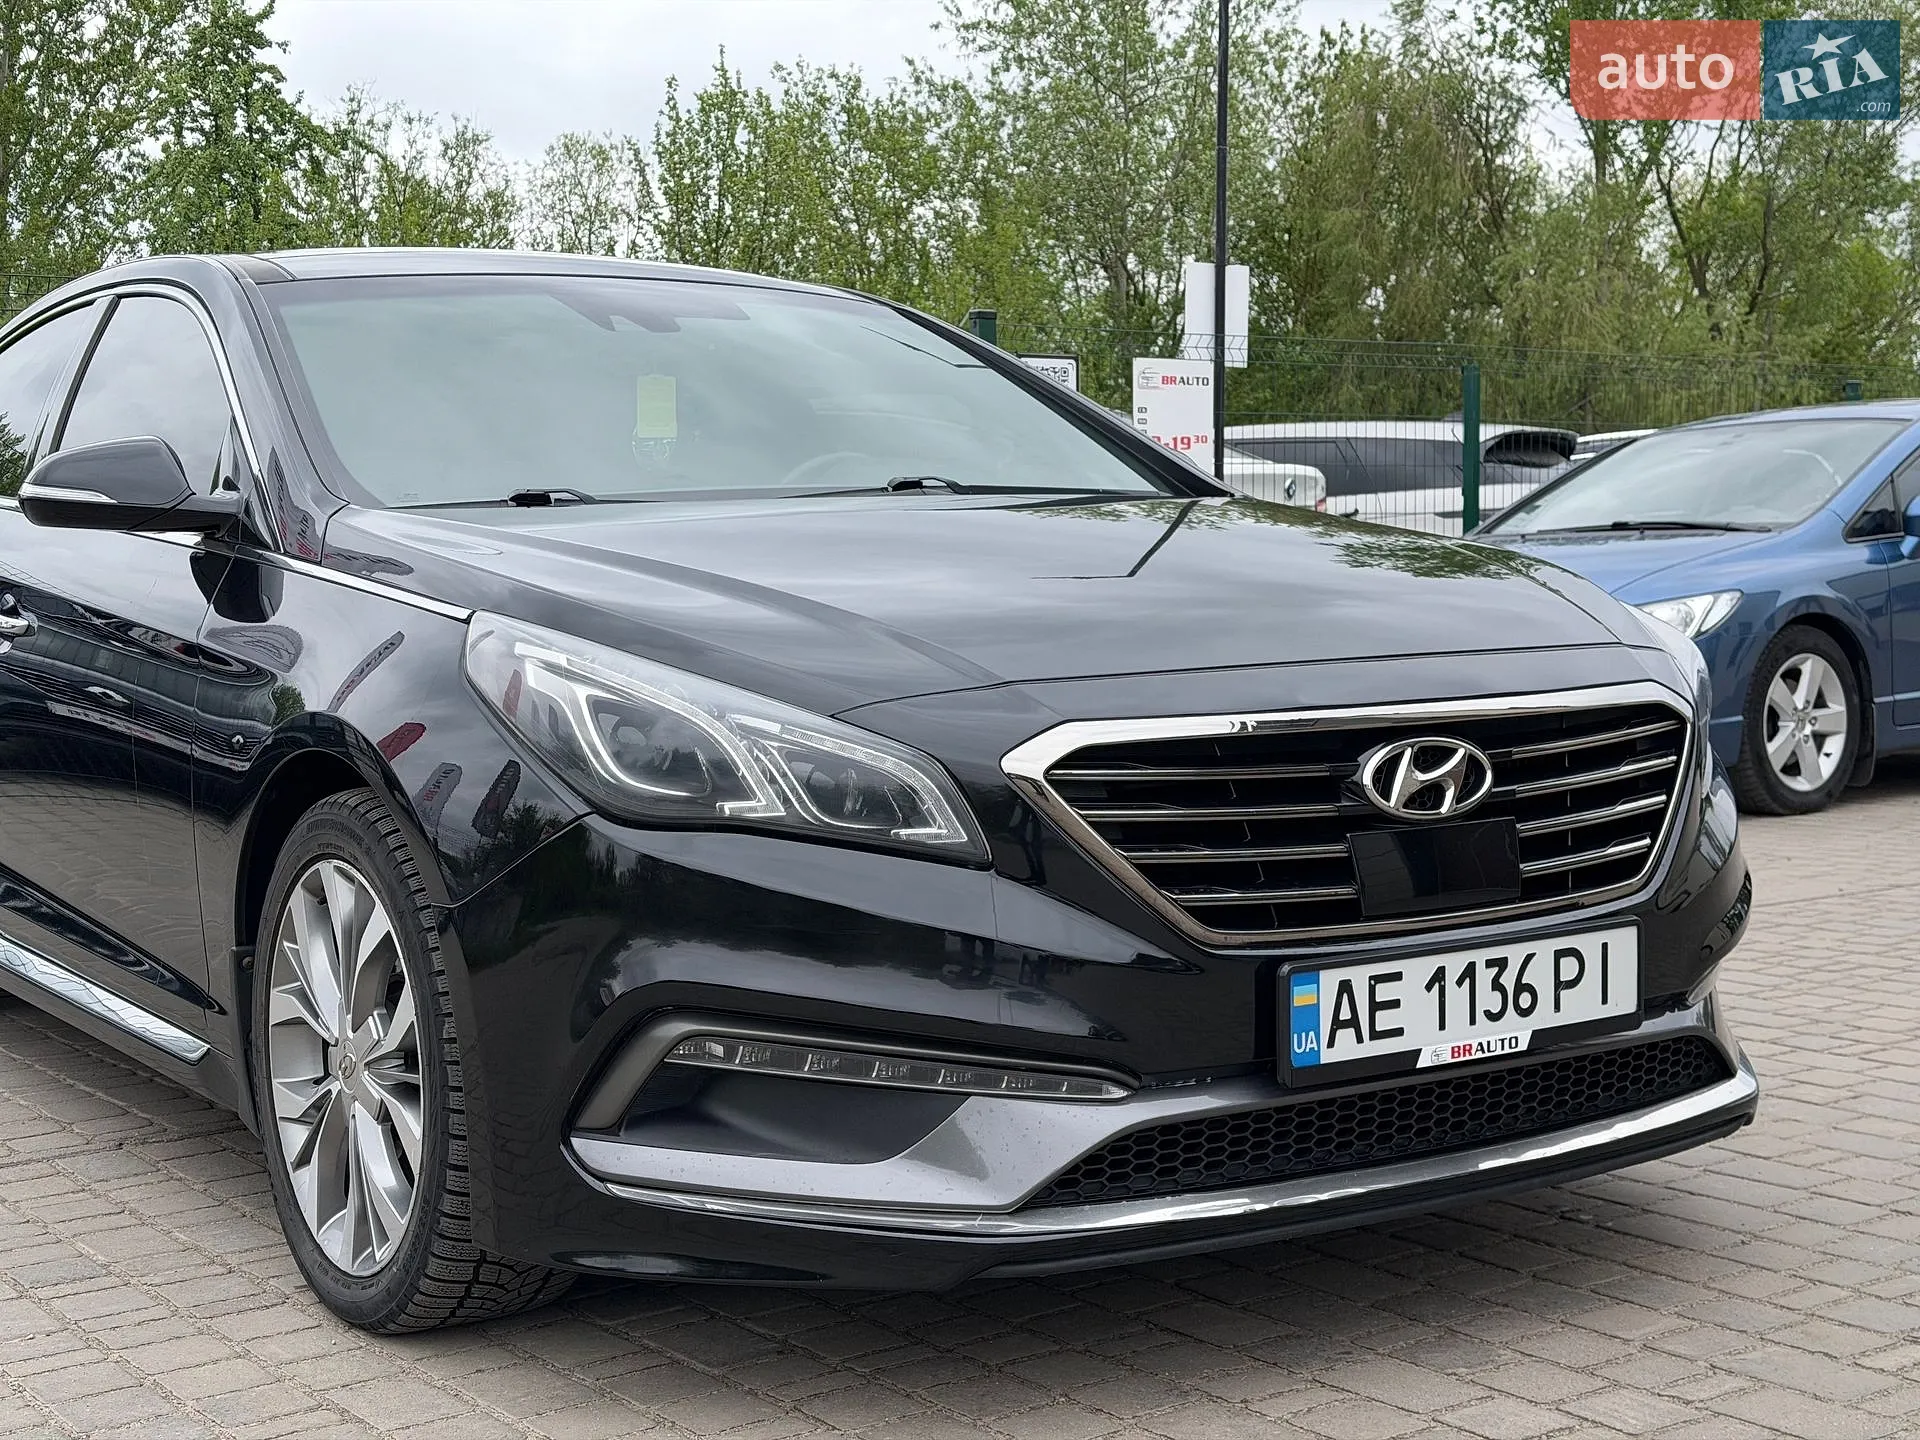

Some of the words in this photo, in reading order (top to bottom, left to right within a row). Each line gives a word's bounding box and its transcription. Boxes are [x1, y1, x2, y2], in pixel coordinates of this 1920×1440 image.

[1161, 375, 1210, 387] BRAUTO
[1327, 971, 1405, 1050] AE
[1424, 952, 1538, 1032] 1136
[1293, 1031, 1319, 1054] UA
[1451, 1036, 1519, 1060] BRAUTO
